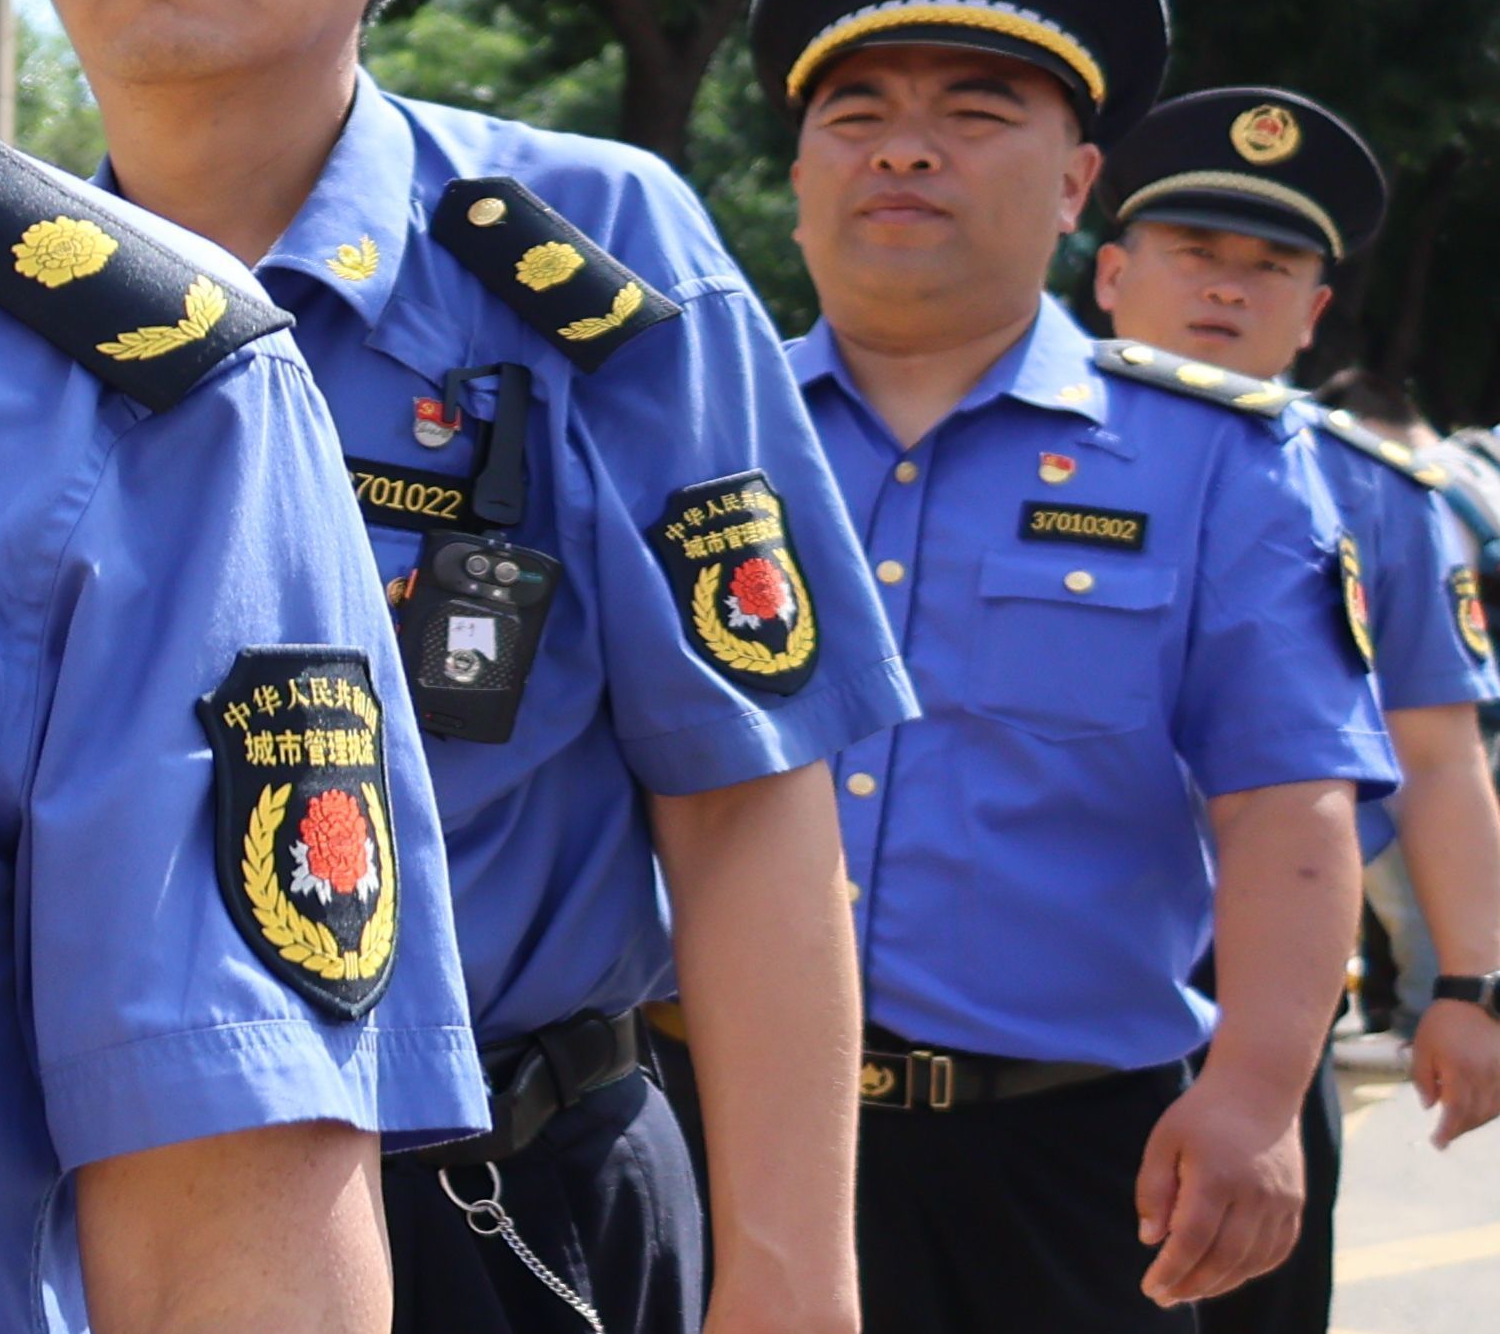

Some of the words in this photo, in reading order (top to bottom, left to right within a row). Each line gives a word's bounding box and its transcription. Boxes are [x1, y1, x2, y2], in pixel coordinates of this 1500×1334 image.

[350, 470, 462, 519] 701022
[1031, 511, 1136, 539] 37010302
[223, 677, 378, 735] 中华人民共和国
[244, 728, 375, 767] 城市管理执法
